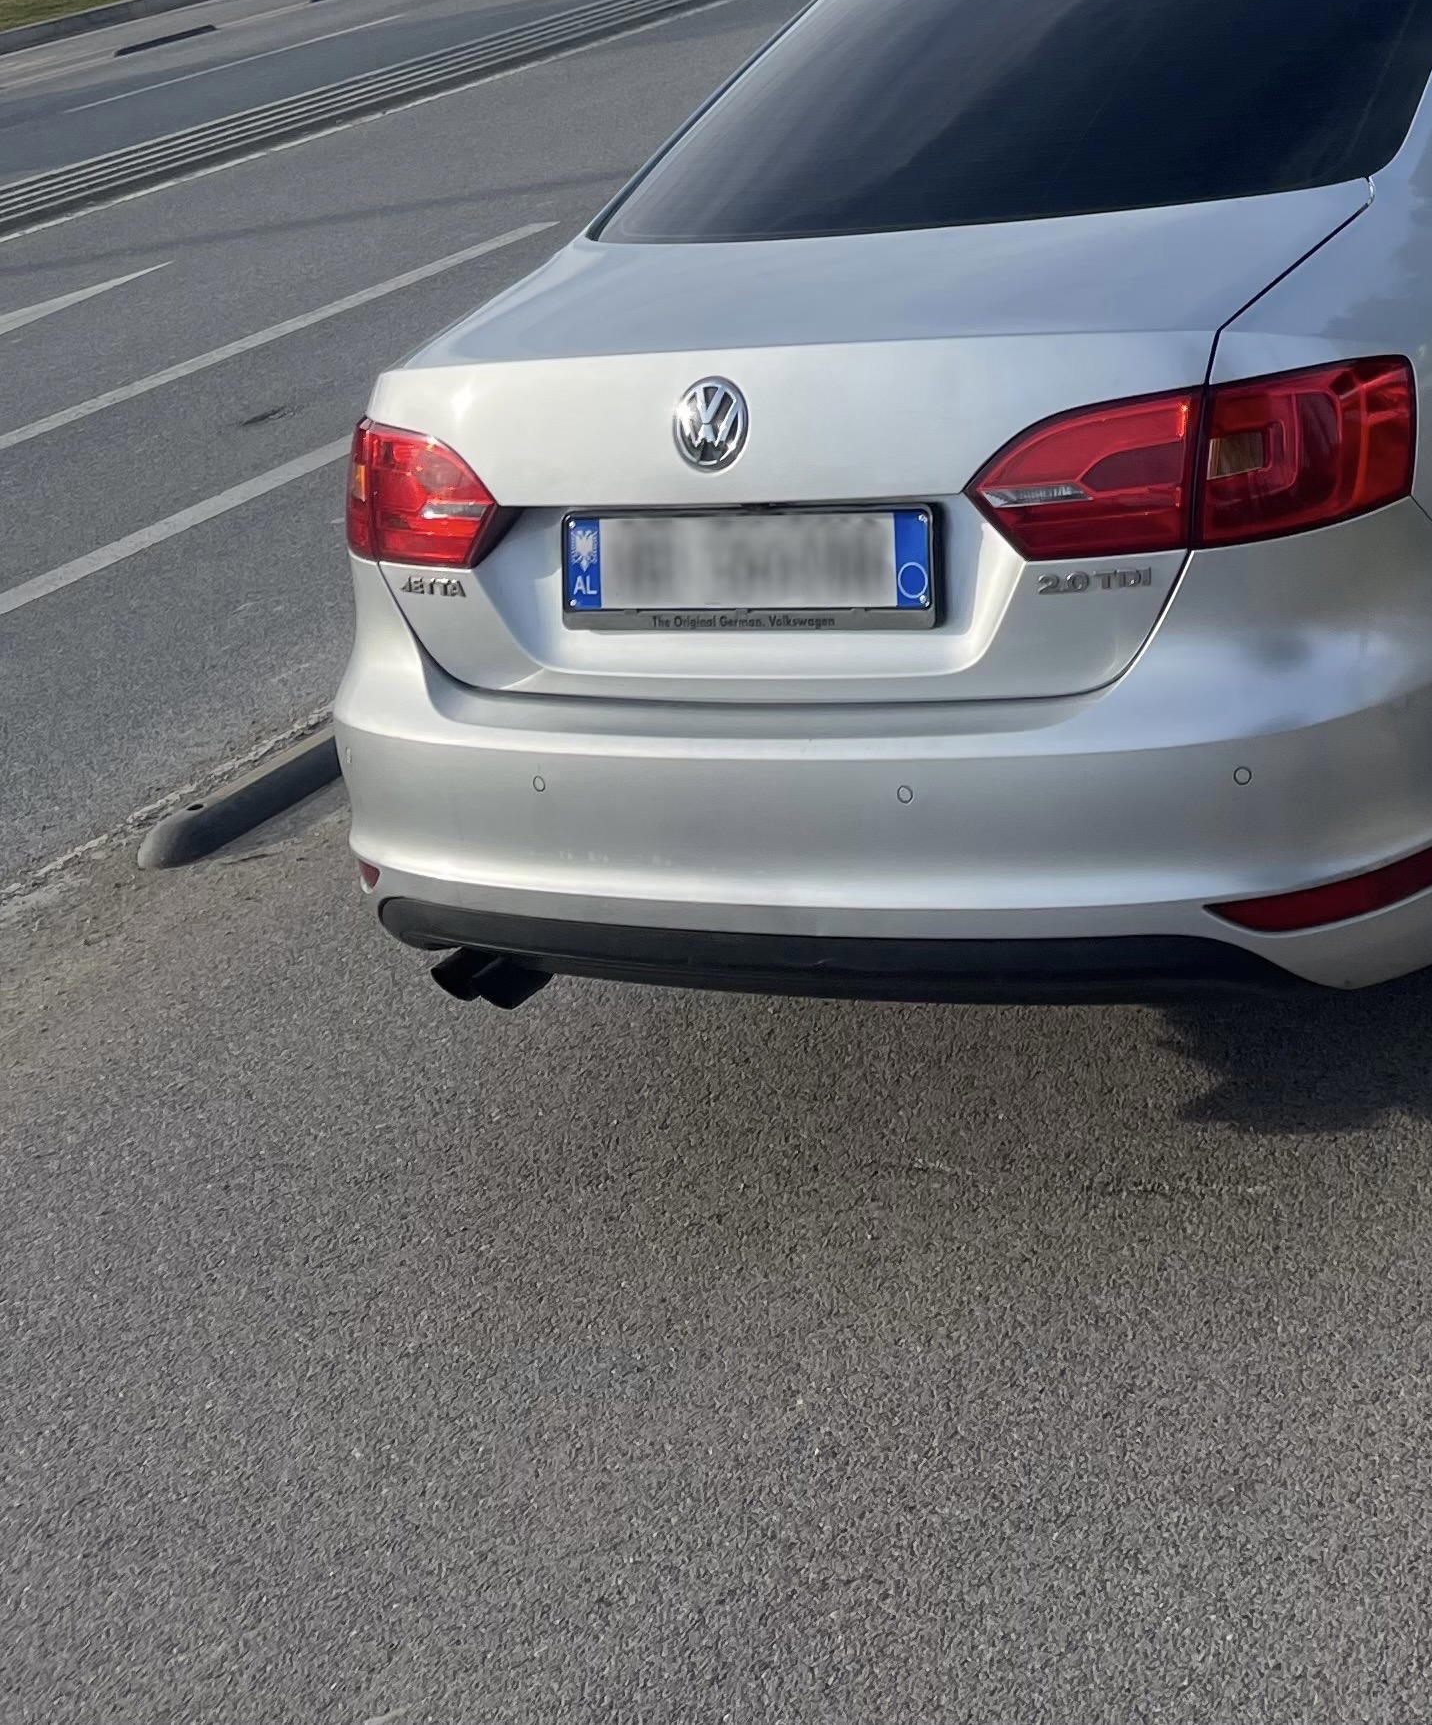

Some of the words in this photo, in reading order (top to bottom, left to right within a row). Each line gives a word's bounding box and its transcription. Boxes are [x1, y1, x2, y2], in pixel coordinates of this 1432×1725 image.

[573, 575, 598, 596] AL
[1092, 566, 1152, 590] TDI
[652, 615, 670, 628] The
[674, 615, 716, 630] Original
[768, 615, 836, 630] Volkswagen
